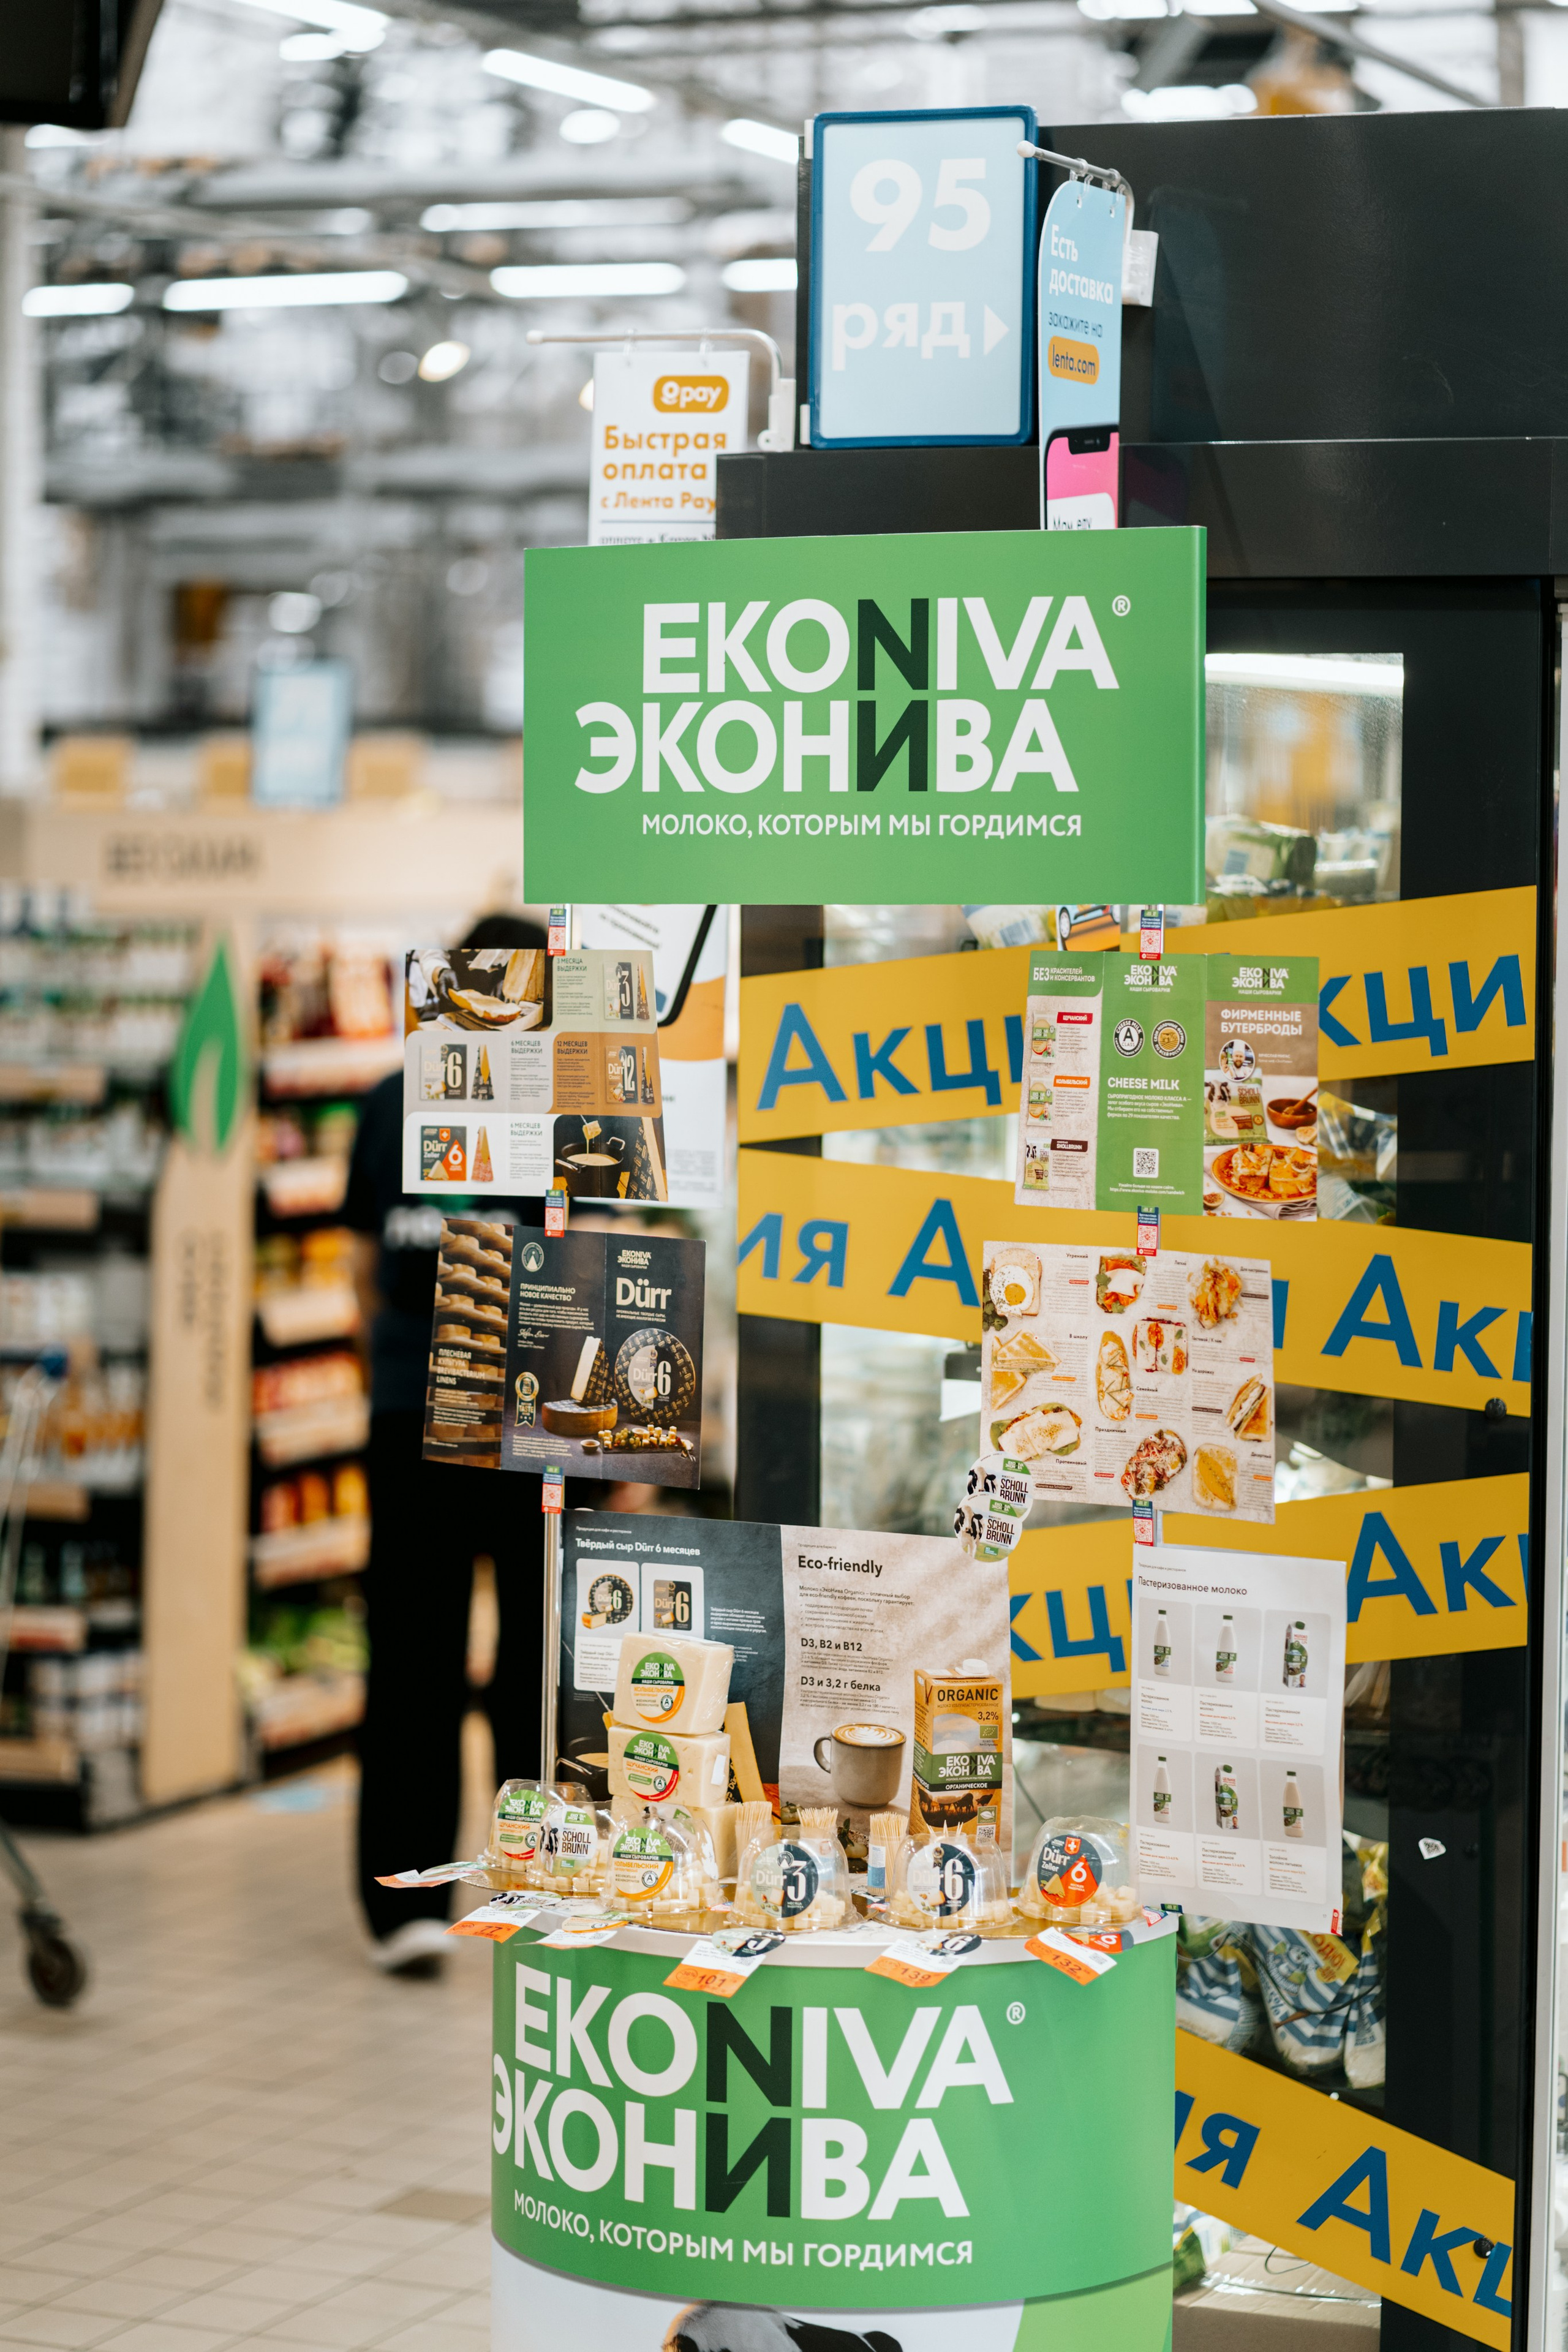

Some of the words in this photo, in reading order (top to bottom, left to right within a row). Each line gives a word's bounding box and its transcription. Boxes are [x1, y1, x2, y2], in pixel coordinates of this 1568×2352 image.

[849, 157, 992, 252] 95
[1050, 224, 1078, 262] Есть
[1049, 268, 1113, 304] доставка
[1049, 312, 1088, 334] закажите
[832, 299, 969, 371] ряд
[1052, 344, 1096, 376] lenta.com
[604, 425, 726, 457] Быстрая
[603, 463, 707, 480] оплата
[613, 492, 674, 508] Лента
[643, 596, 1120, 694] EKONIVA
[575, 698, 1080, 794] ЭКОНИВА
[643, 814, 753, 839] МОЛОКО,
[758, 814, 881, 837] КОТОРЫМ
[889, 815, 931, 836] МЫ
[939, 815, 1083, 840] ГОРДИМСЯ
[1033, 967, 1050, 981] БЕЗ
[1131, 965, 1177, 976] EKONIVA
[1239, 967, 1289, 979] EKONIVA
[1124, 974, 1174, 986] ЭКОНИВА
[1232, 977, 1285, 989] ЭКОНИВА
[1221, 1008, 1302, 1022] ФИРМЕННЫЕ
[1221, 1022, 1302, 1036] БУТЕРБРОДЫ
[447, 1052, 462, 1088] 6
[1107, 1077, 1148, 1089] CHEESE
[1150, 1079, 1180, 1090] MILK
[448, 1144, 462, 1165] 6
[520, 1283, 576, 1294] ПРИНЦИПИАЛЬНО
[616, 1277, 672, 1310] Dürr
[540, 1292, 572, 1302] КАЧЕСТВО
[657, 1360, 671, 1395] 6
[1001, 1478, 1028, 1493] SCHOLL
[987, 1519, 1015, 1535] SCHOLL
[986, 1529, 1012, 1545] BRUNN
[575, 1538, 614, 1551] Твёрдый
[616, 1543, 634, 1553] сыр
[635, 1542, 655, 1552] Dürr
[655, 1544, 662, 1553] 6
[663, 1546, 701, 1556] месяцев
[797, 1555, 883, 1578] Eco-friendly
[1138, 1575, 1209, 1593] Пастеризованное
[1211, 1586, 1247, 1595] молоко
[612, 1589, 622, 1610] 6
[676, 1591, 690, 1623] 6
[801, 1638, 818, 1649] D3,
[640, 1668, 673, 1678] ЭКОНИВА
[645, 1662, 676, 1672] EKONIVA
[801, 1676, 815, 1686] D3
[826, 1678, 842, 1689] 3,2
[850, 1680, 881, 1692] белка
[938, 1689, 998, 1702] ORGANIC
[977, 1711, 999, 1721] 3,2%
[633, 1746, 667, 1761] ЭКОНИВА
[639, 1739, 670, 1754] EKONIVA
[946, 1754, 996, 1766] EKONIVA
[938, 1765, 992, 1777] ЭКОНИВА
[562, 1831, 591, 1844] SCHOLL
[562, 1842, 589, 1855] BRUNN
[1043, 1847, 1071, 1866] Dürr
[1042, 1861, 1060, 1872] Zeller
[1071, 1862, 1087, 1883] 6
[787, 1860, 807, 1902] 3
[944, 1858, 963, 1900] 6
[1052, 1954, 1082, 1975] 132
[698, 1975, 726, 1988] 101
[900, 1967, 931, 1981] 139
[515, 1962, 1015, 2111] EKONIVA
[492, 2054, 971, 2220] ЭКОНИВА
[514, 2188, 596, 2244] МОЛОКО,
[599, 2220, 734, 2263] КОТОРЫМ
[743, 2237, 794, 2266] МЫ
[804, 2240, 973, 2272] ГОРДИМСЯ
